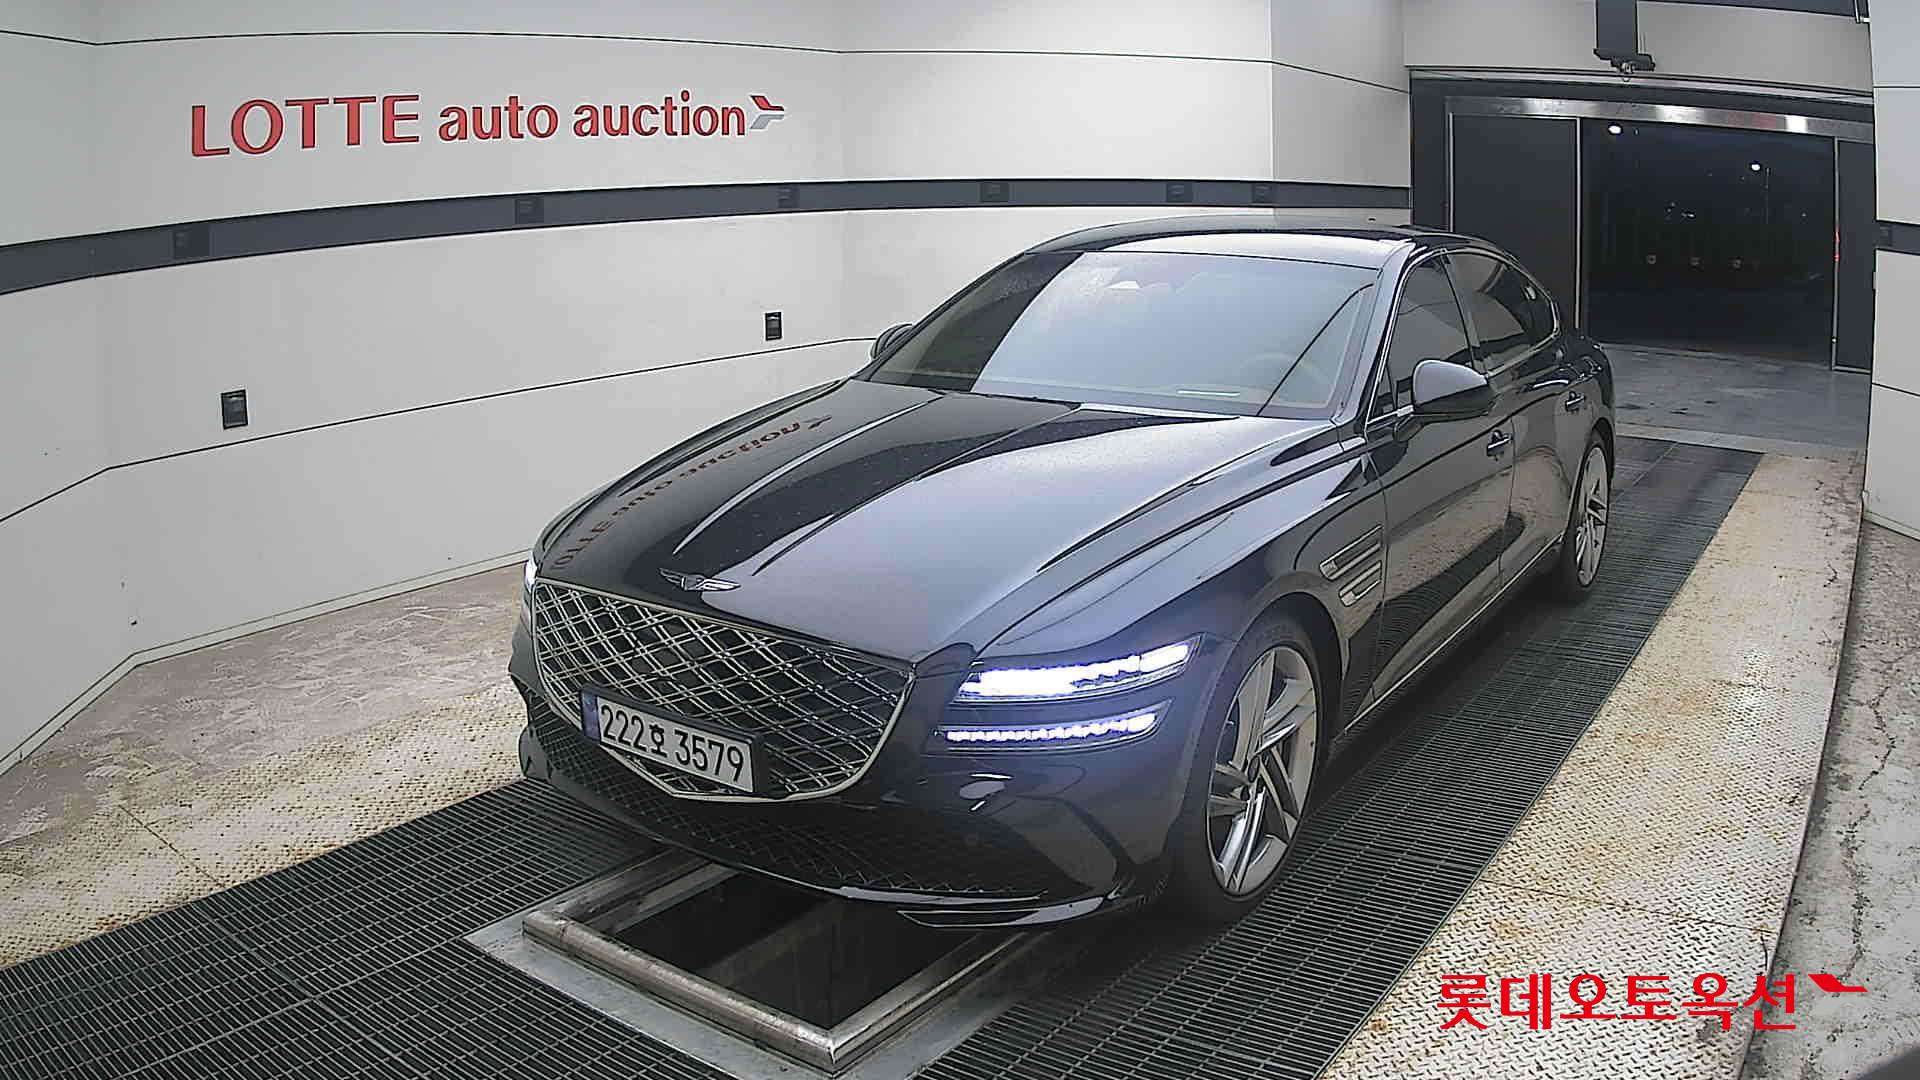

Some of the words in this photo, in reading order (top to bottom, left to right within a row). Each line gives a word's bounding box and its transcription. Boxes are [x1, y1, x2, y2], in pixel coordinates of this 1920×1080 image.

[191, 94, 420, 158] LOTTE
[437, 95, 559, 142] auto
[573, 90, 746, 137] auction
[601, 704, 668, 759] 222호
[674, 728, 744, 782] 3579
